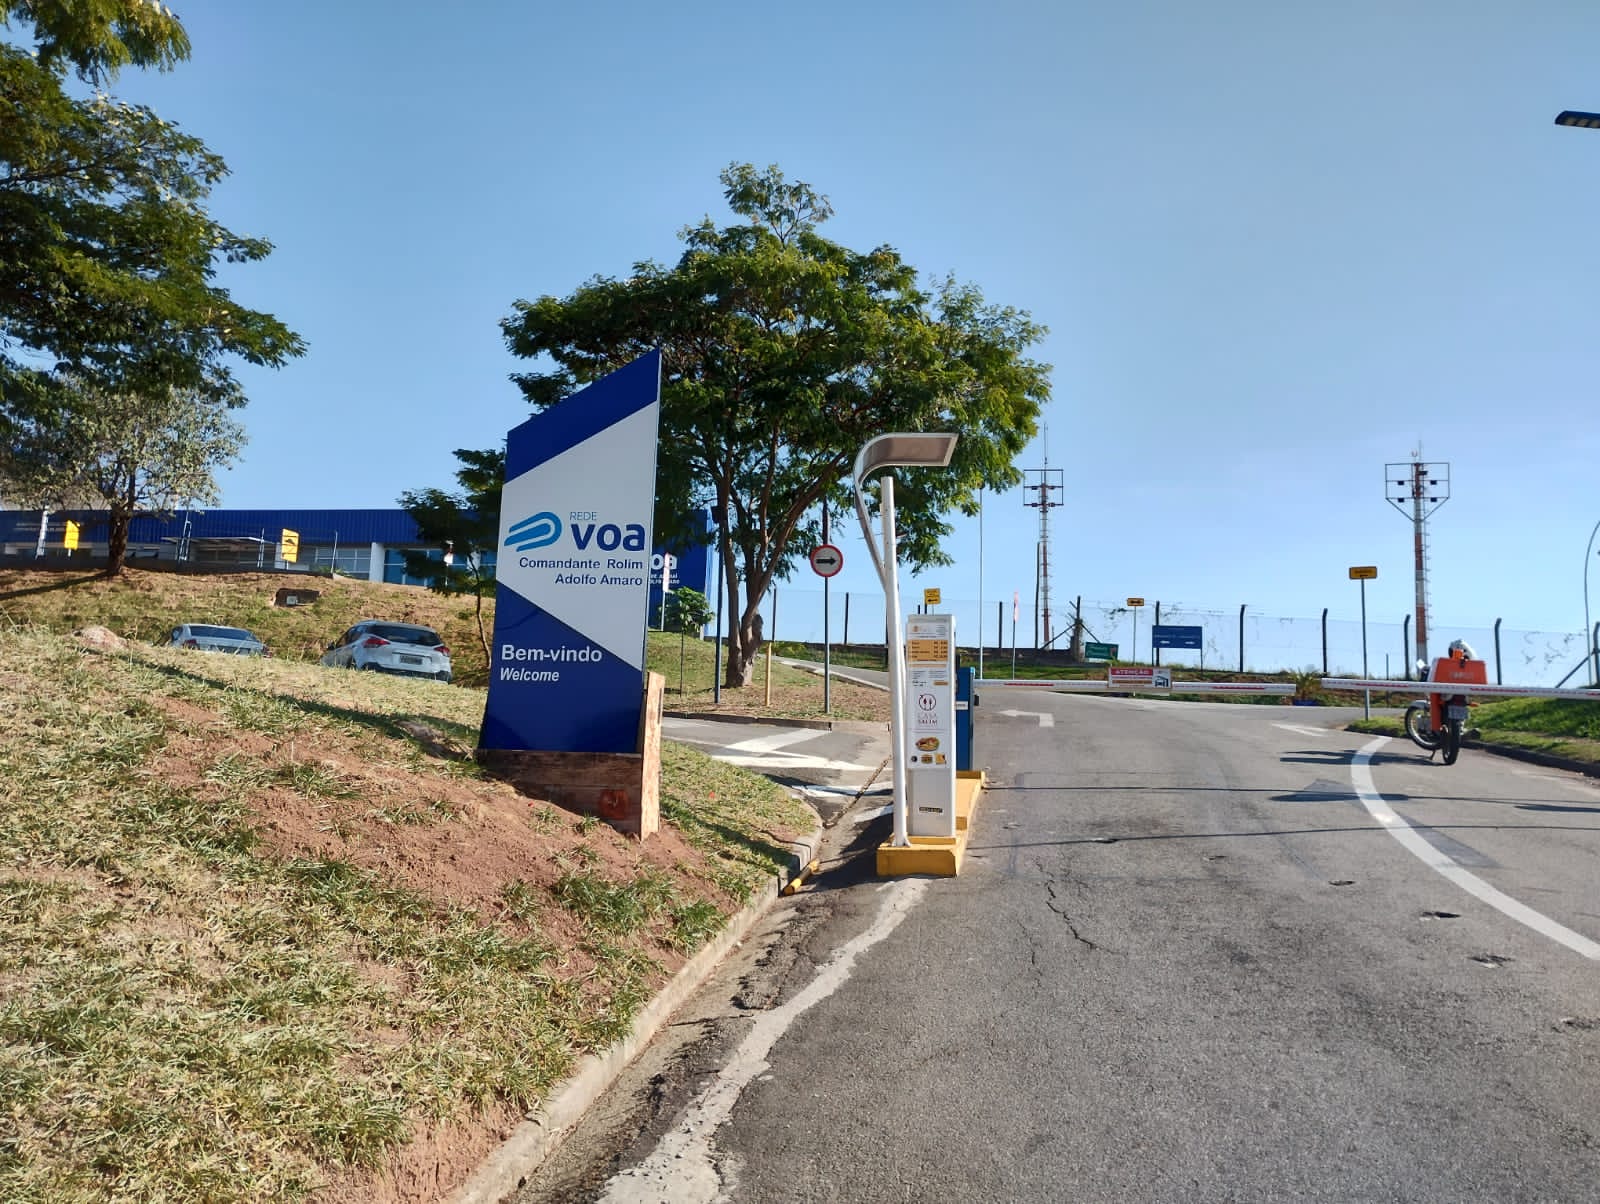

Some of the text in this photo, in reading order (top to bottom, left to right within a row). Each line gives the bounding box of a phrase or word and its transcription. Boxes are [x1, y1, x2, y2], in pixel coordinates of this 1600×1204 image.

[570, 511, 597, 521] REDE
[571, 523, 645, 553] voa
[519, 557, 643, 570] Comandante Rolim
[555, 573, 643, 586] Adolfo Amaro
[501, 644, 602, 662] Bem-vindo
[500, 667, 560, 682] Welcome
